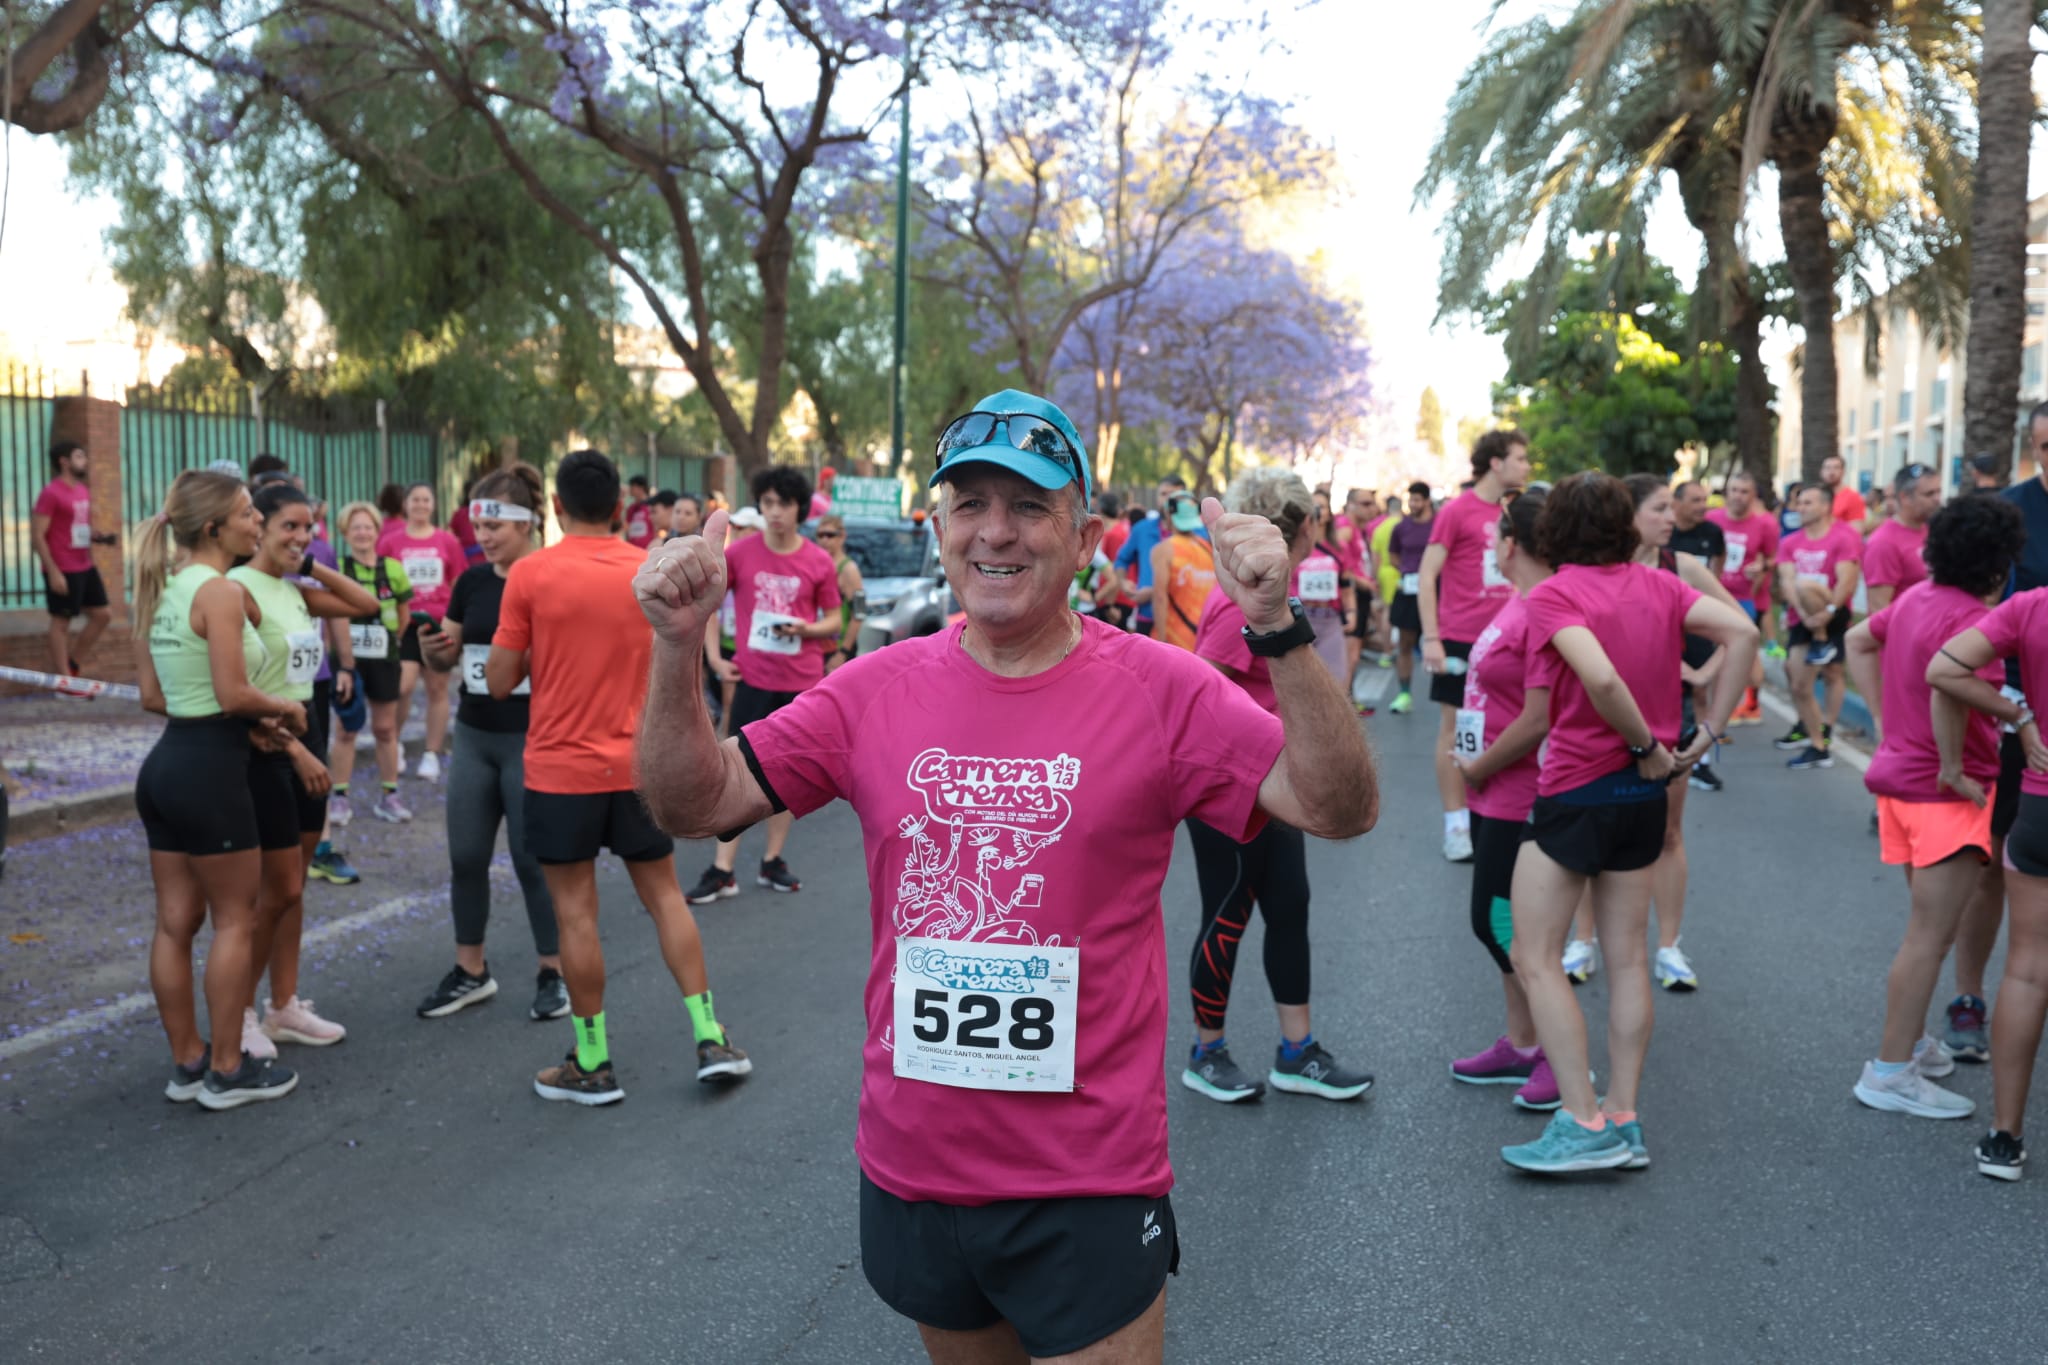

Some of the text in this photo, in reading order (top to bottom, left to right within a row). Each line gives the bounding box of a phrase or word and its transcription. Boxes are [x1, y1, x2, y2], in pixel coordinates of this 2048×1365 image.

[917, 755, 1077, 784] Carrera de
[938, 782, 1054, 811] Prensa
[928, 954, 1026, 977] Carrera
[912, 988, 1055, 1051] 528
[985, 1052, 1015, 1062] MIGUEL
[1015, 1054, 1041, 1063] ANGEL
